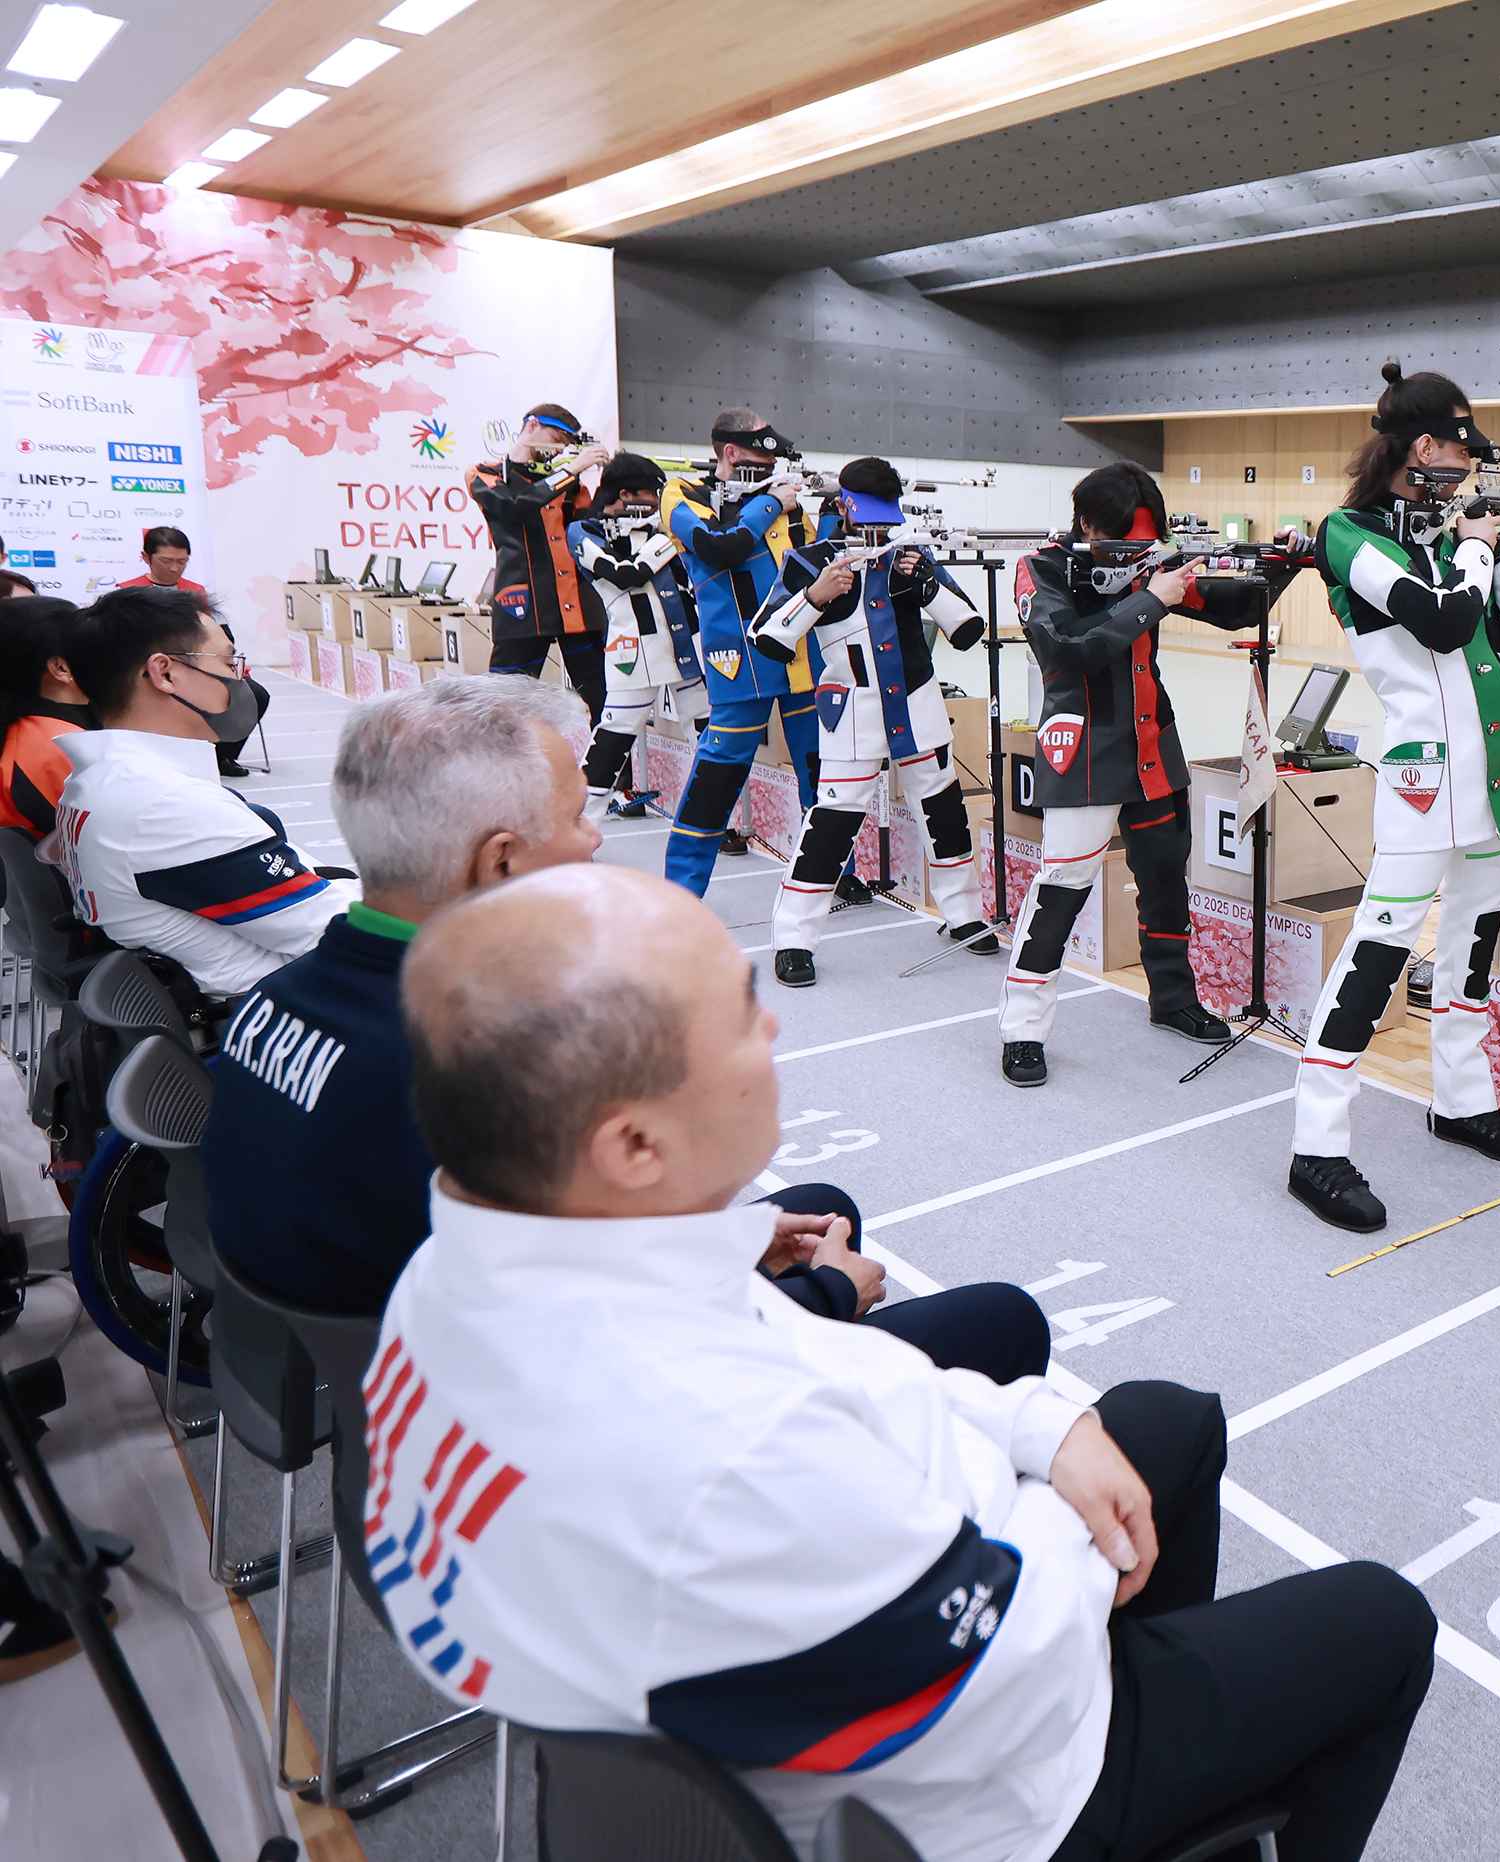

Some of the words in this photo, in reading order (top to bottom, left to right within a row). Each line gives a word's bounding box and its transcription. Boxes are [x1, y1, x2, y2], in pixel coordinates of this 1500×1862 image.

[38, 391, 136, 415] SoftBank
[38, 442, 96, 455] SHIONOGI
[114, 444, 174, 462] NISHI
[18, 473, 99, 487] LINEヤフー
[1247, 468, 1254, 481] 2
[140, 478, 182, 492] YONEX
[337, 482, 468, 512] TOKYO
[340, 521, 492, 549] DEAFLY
[709, 649, 738, 662] UKR
[664, 684, 671, 712] A
[1044, 731, 1075, 747] KOR
[1021, 764, 1034, 805] D
[1218, 811, 1237, 859] E
[1016, 841, 1034, 857] 2025
[1204, 897, 1229, 915] 2025
[1018, 1258, 1178, 1352] 14
